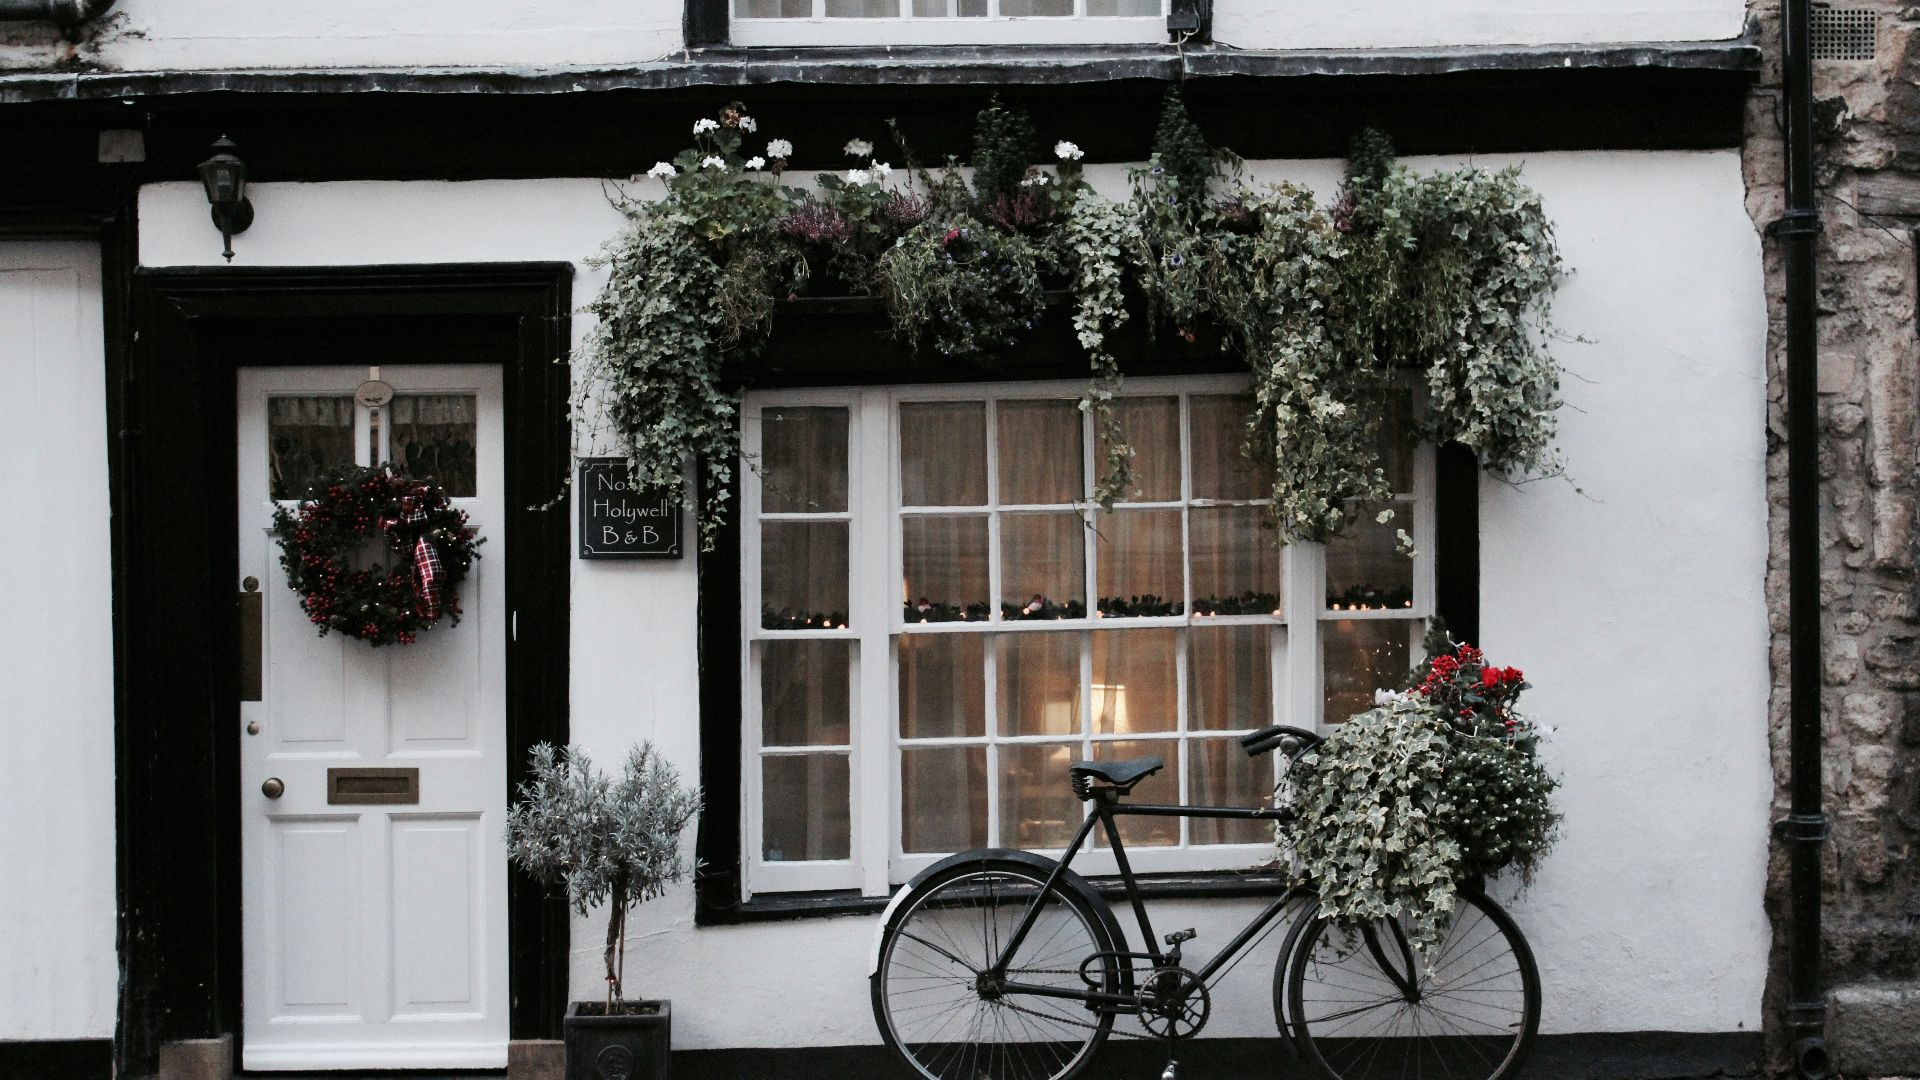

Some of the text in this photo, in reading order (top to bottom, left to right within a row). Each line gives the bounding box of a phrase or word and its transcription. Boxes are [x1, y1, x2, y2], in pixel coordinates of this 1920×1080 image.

[593, 498, 668, 524] Holywell
[602, 525, 659, 545] B & B
